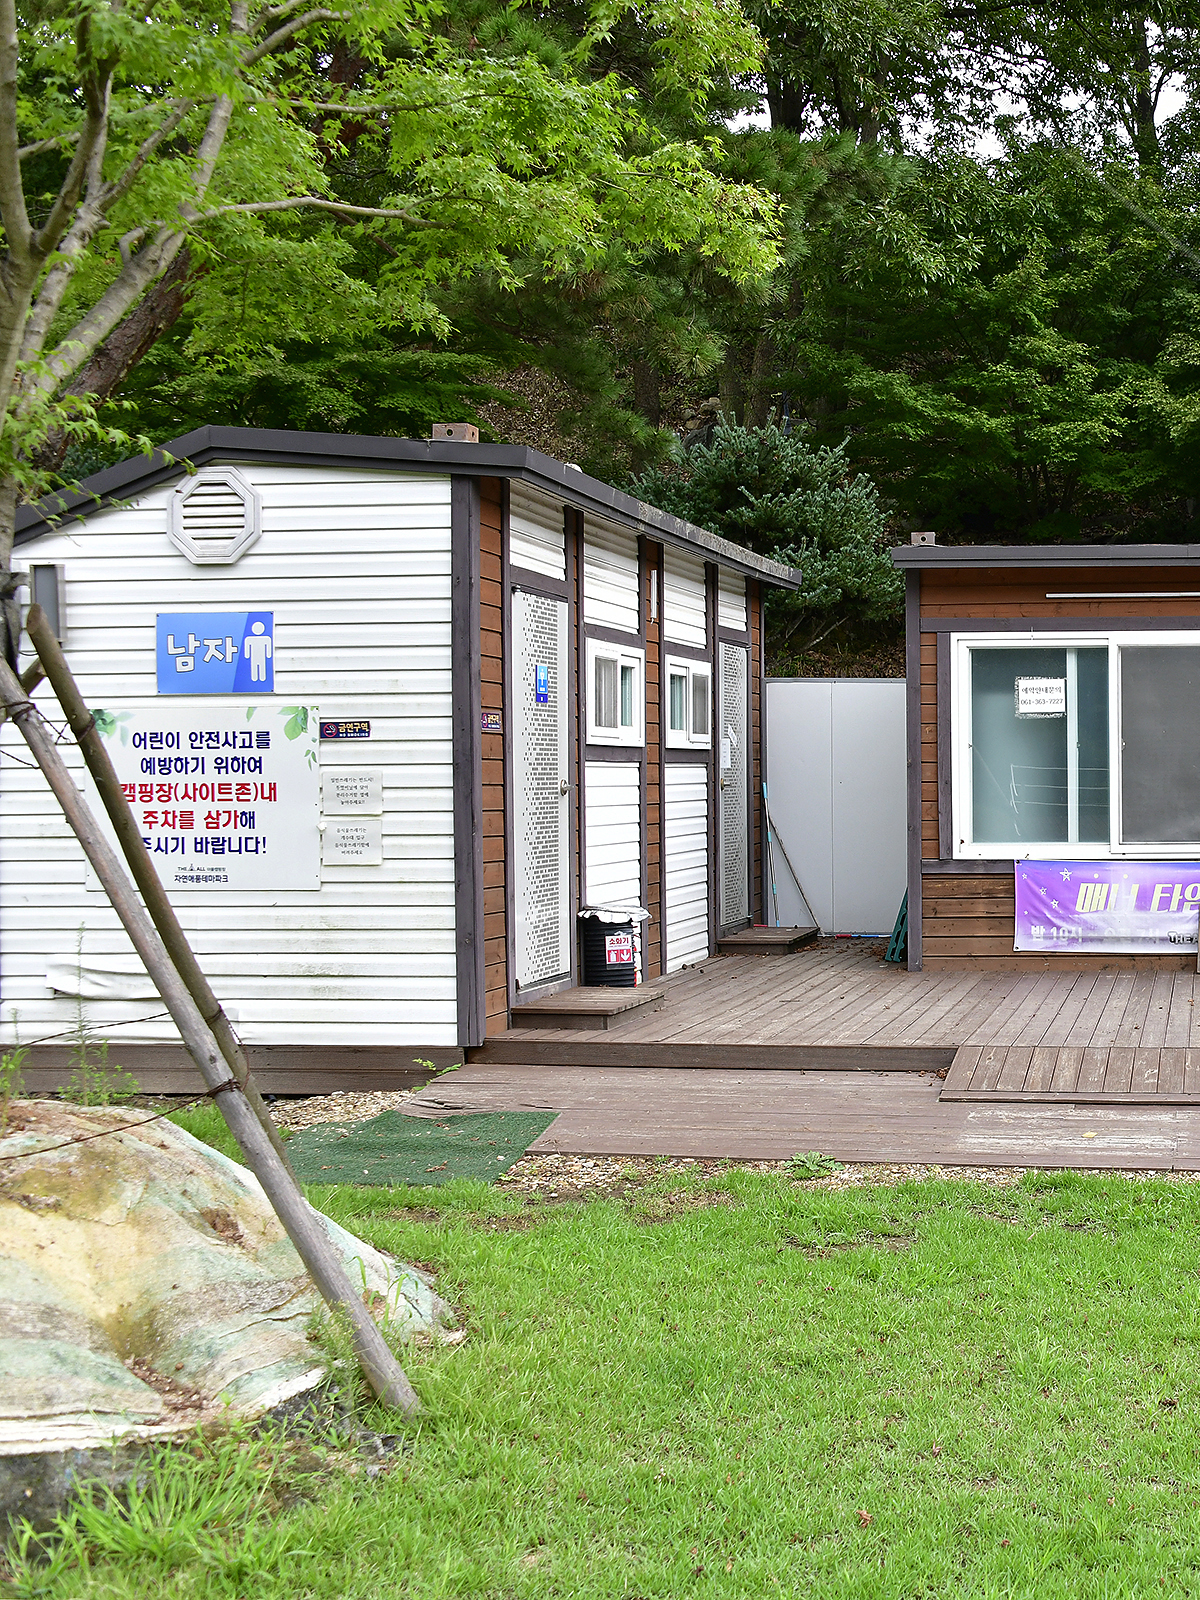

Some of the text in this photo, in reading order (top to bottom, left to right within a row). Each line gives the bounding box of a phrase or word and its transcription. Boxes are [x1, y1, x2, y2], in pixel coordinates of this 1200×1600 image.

[167, 633, 238, 673] 남자
[338, 723, 369, 732] 금연구역
[132, 731, 271, 750] 어린이 안전사고를
[140, 756, 263, 775] 예방하기 위하여
[142, 810, 256, 830] 주차를 삼가해
[194, 836, 267, 855] 바랍니다!
[609, 937, 629, 945] 소화기
[1031, 925, 1046, 941] 밤
